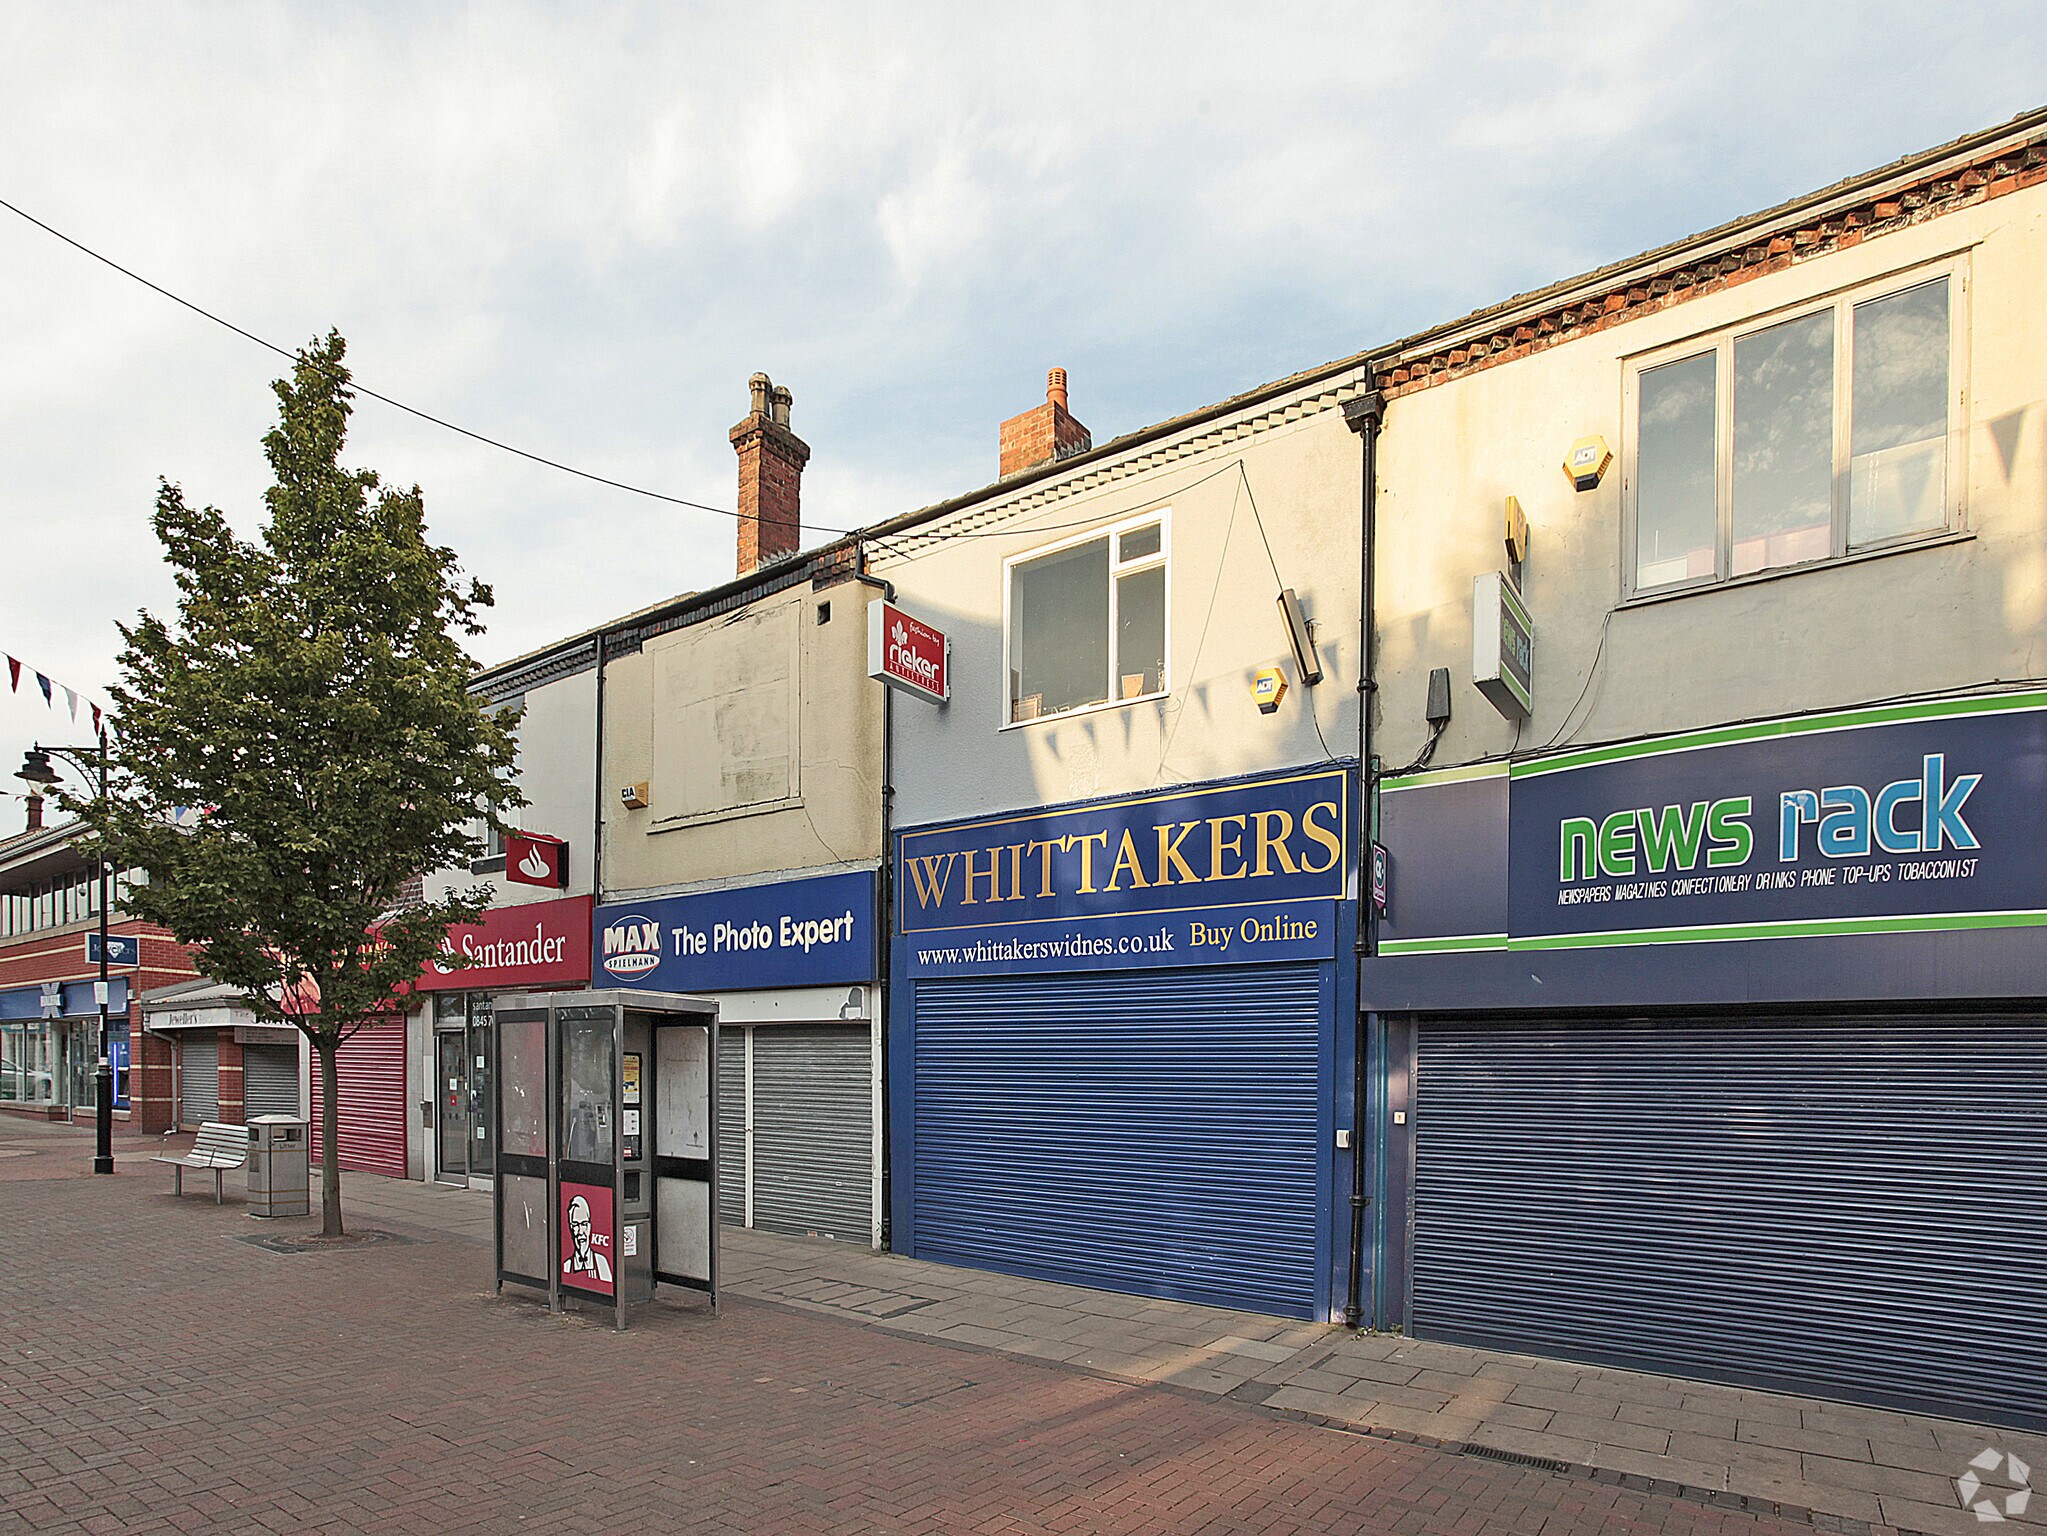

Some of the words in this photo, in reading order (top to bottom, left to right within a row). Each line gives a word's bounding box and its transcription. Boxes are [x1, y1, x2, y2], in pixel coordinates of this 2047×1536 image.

[1574, 448, 1597, 465] ADT
[932, 633, 940, 647] by
[889, 643, 940, 679] rieker
[889, 662, 939, 692] ANTISTRESS
[1257, 680, 1273, 692] ADT
[621, 786, 635, 798] CIA
[1560, 795, 1754, 883] news
[1779, 753, 1983, 863] rack
[904, 801, 1341, 910] WHITTAKERS
[1557, 884, 1611, 906] NEWSPAPERS
[1614, 881, 1667, 902] MAGAZINES
[1671, 874, 1752, 898] CONFECTIONERY
[1755, 870, 1797, 890] DRINKS
[1801, 867, 1836, 887] PHONE
[1841, 863, 1892, 884] TOP-UPS
[1897, 858, 1979, 881] TOBACCONIST
[462, 922, 566, 971] Santander
[603, 921, 660, 956] MAX
[671, 925, 707, 957] The
[713, 920, 773, 953] Photo
[779, 909, 855, 954] Expert
[917, 926, 1175, 965] www.whittakerswidnes.co.uk
[1189, 922, 1234, 952] Buy
[1240, 914, 1318, 944] Online
[608, 956, 655, 969] SPIELMANN
[472, 1015, 488, 1027] 0845
[591, 1233, 610, 1247] KFC
